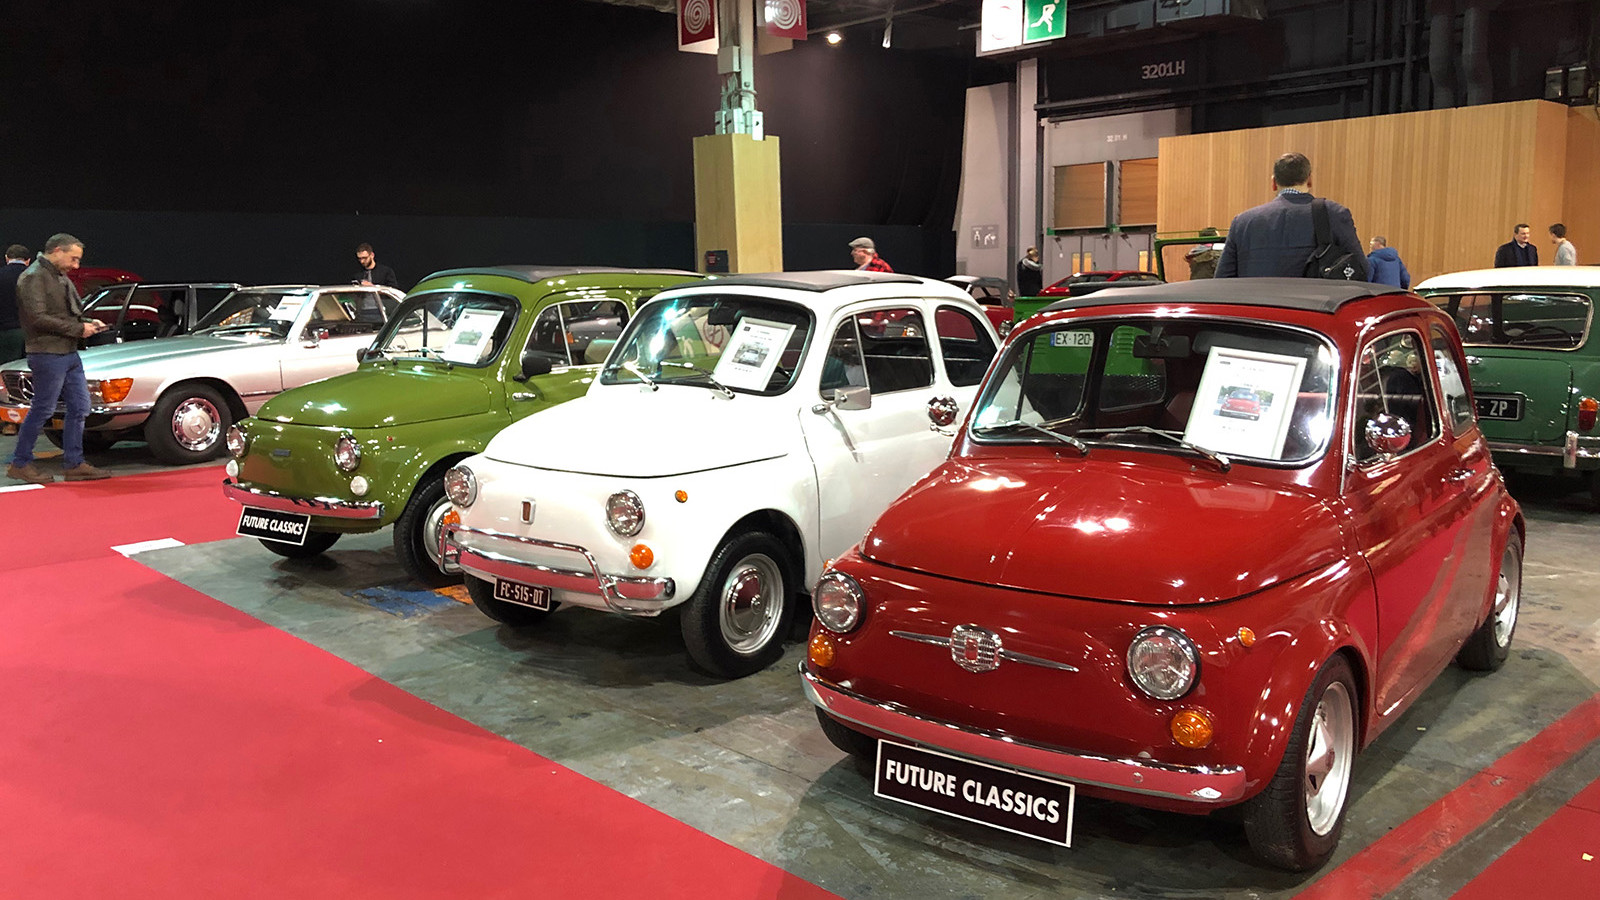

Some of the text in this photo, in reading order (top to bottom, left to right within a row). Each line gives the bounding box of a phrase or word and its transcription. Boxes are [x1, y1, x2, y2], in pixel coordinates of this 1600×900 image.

[242, 514, 304, 536] FUTURE CLASSICS
[885, 759, 1060, 824] FUTURE CLASSICS
